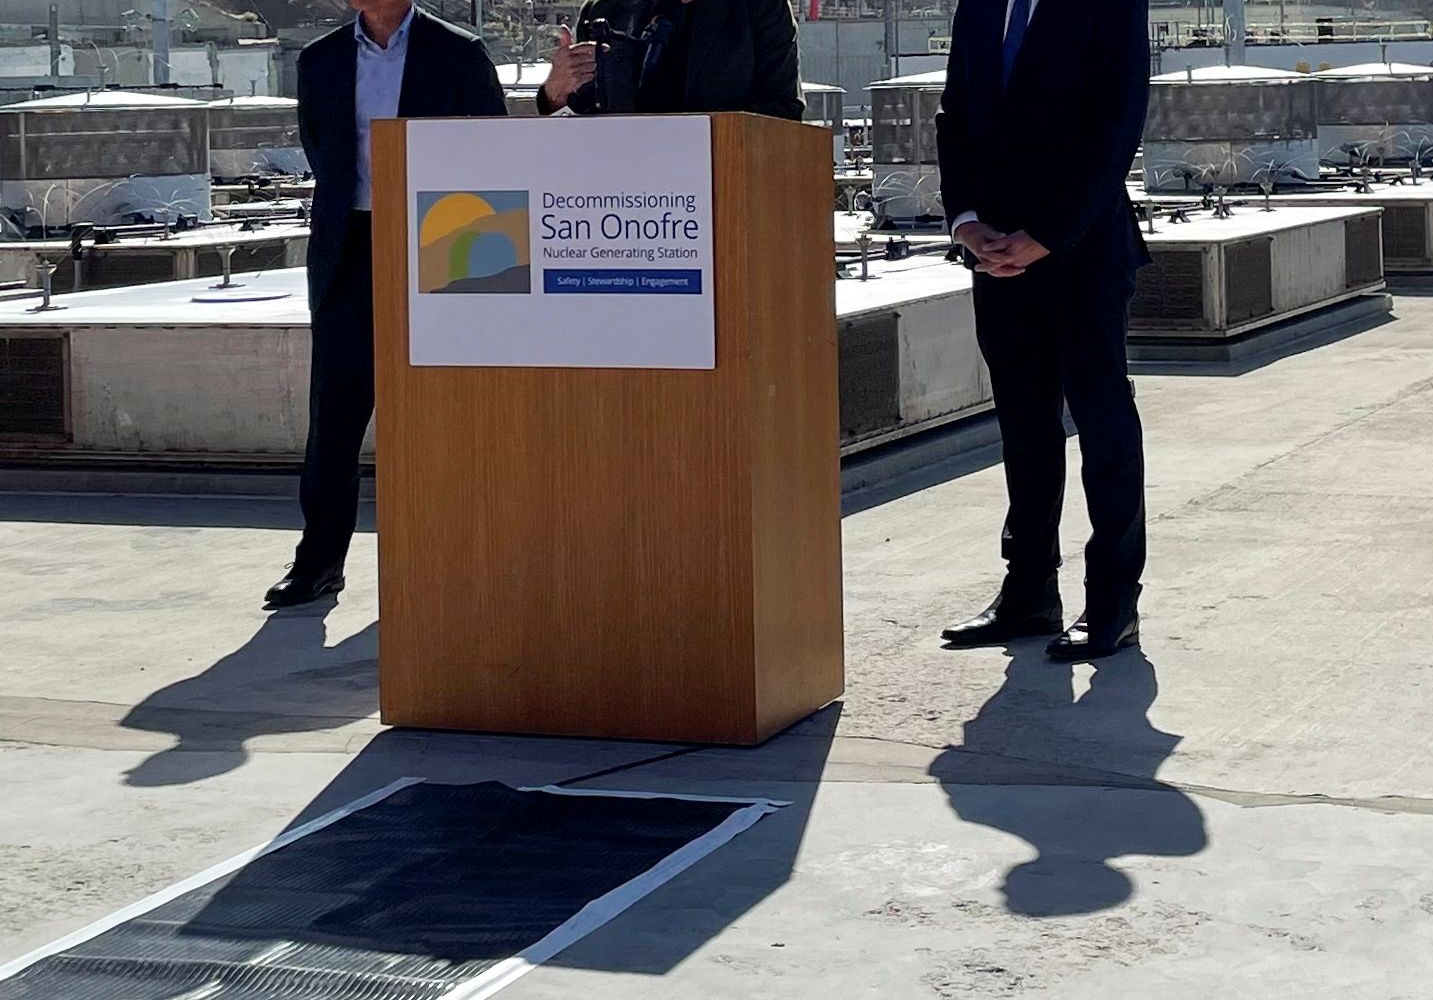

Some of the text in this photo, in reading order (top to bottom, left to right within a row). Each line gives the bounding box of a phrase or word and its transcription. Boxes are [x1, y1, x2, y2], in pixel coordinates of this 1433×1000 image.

[542, 191, 697, 212] Decommissioning
[541, 211, 699, 240] San Onofre
[543, 246, 698, 262] Nuclear Generating Station
[556, 276, 581, 288] Safety
[587, 276, 634, 288] Stewardship
[641, 276, 689, 288] Engagement
